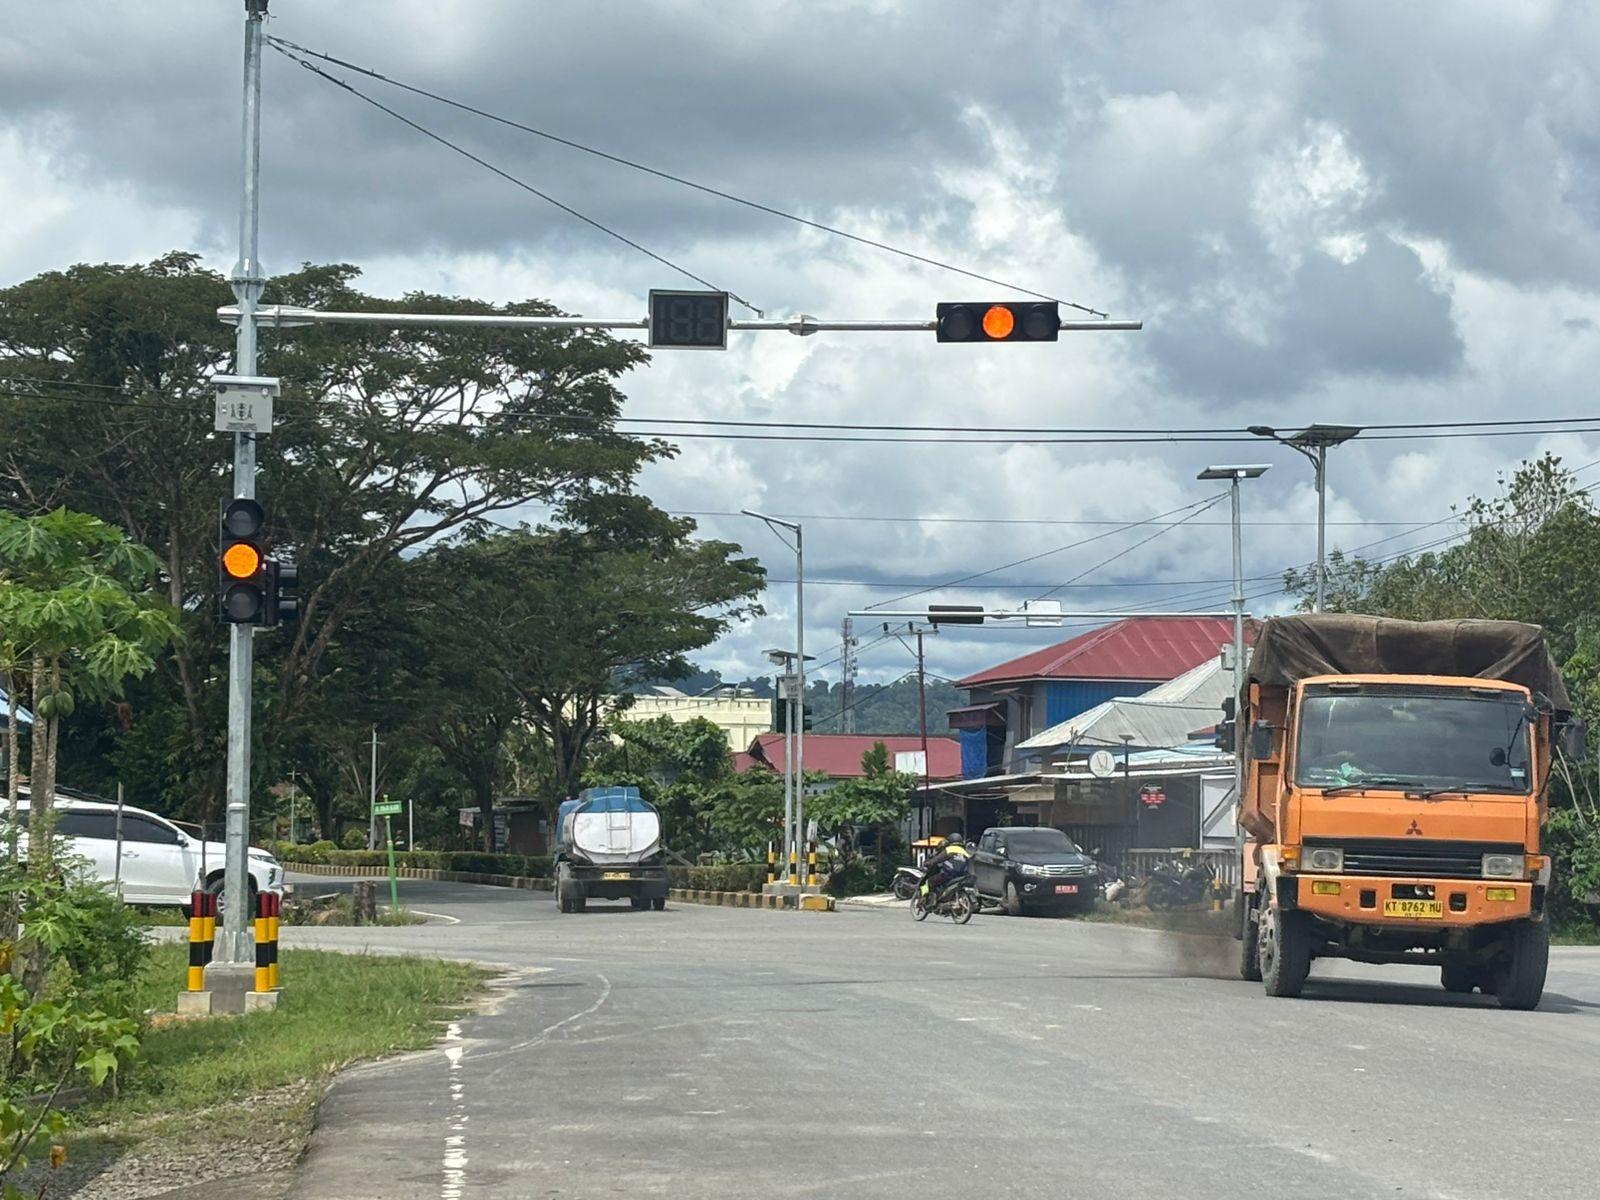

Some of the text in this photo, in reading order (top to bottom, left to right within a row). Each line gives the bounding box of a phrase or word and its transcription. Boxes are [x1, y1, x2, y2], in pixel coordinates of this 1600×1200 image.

[1385, 902, 1441, 913] KT 8762 MU
